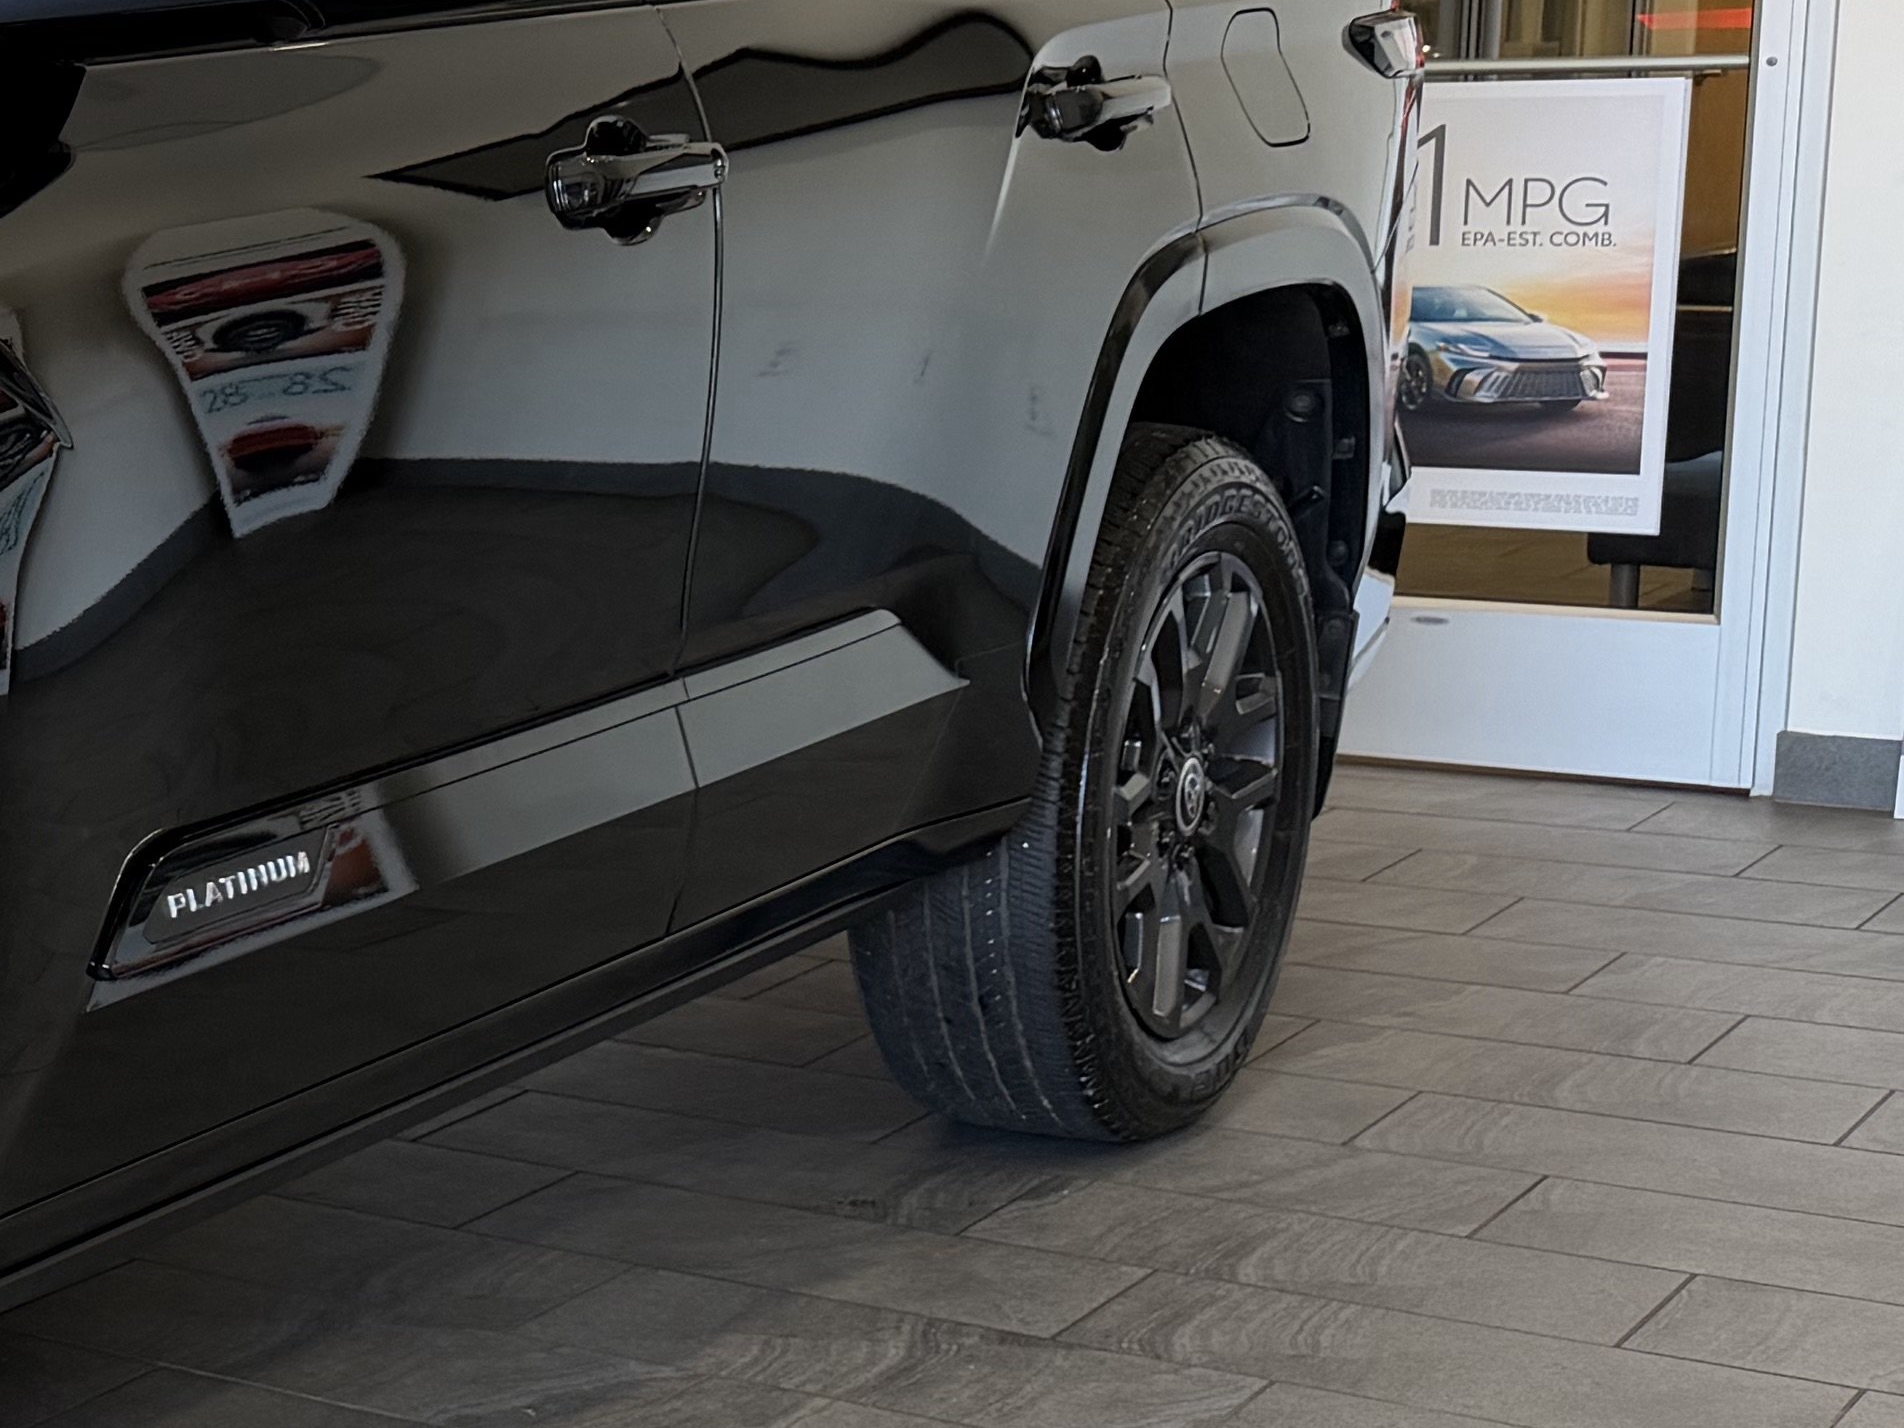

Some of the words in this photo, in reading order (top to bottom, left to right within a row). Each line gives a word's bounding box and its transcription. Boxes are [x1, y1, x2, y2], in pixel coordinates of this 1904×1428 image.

[1463, 176, 1610, 227] MPG
[1461, 231, 1543, 247] EPA-EST.
[1549, 231, 1617, 248] COMB.
[166, 851, 311, 918] PLATINUM
